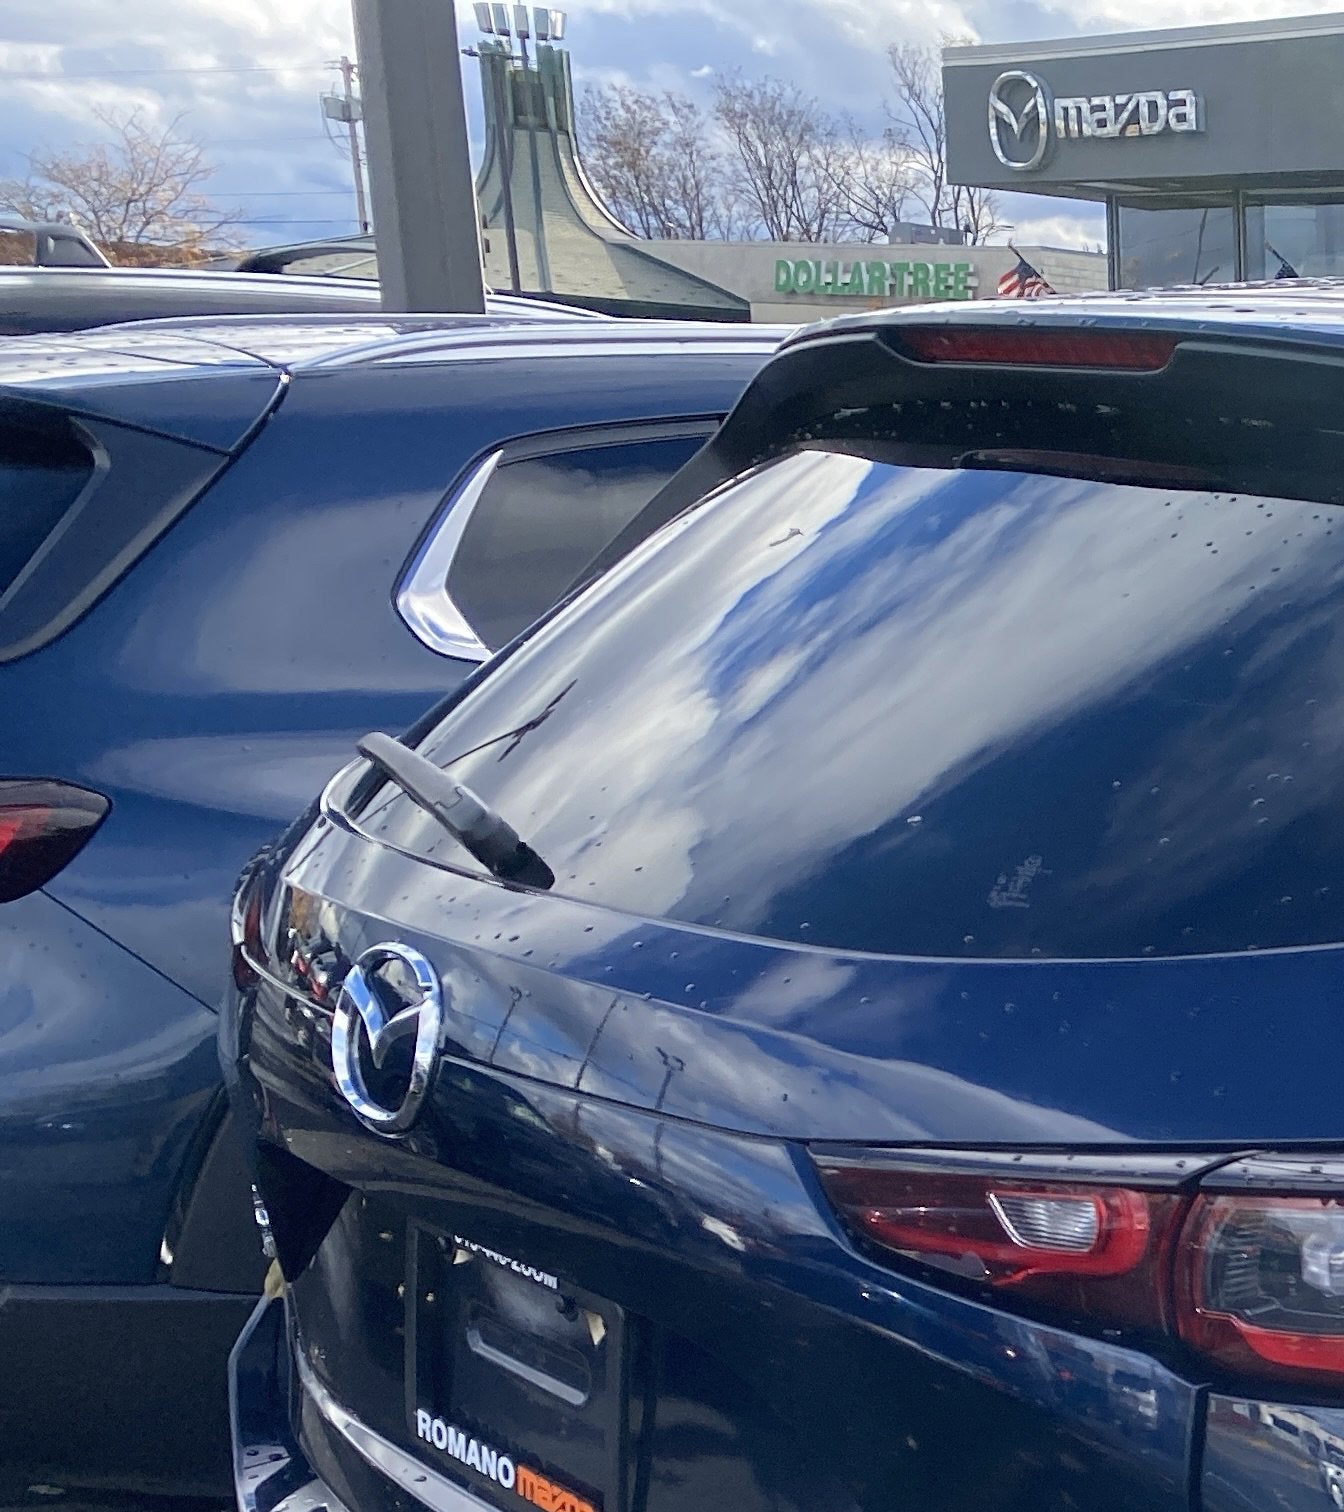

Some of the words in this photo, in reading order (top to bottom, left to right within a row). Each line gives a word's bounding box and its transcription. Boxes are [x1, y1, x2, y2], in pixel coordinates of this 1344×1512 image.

[774, 258, 890, 297] DOLLAR
[893, 260, 977, 300] TREE
[416, 1407, 516, 1489] ROMANO
